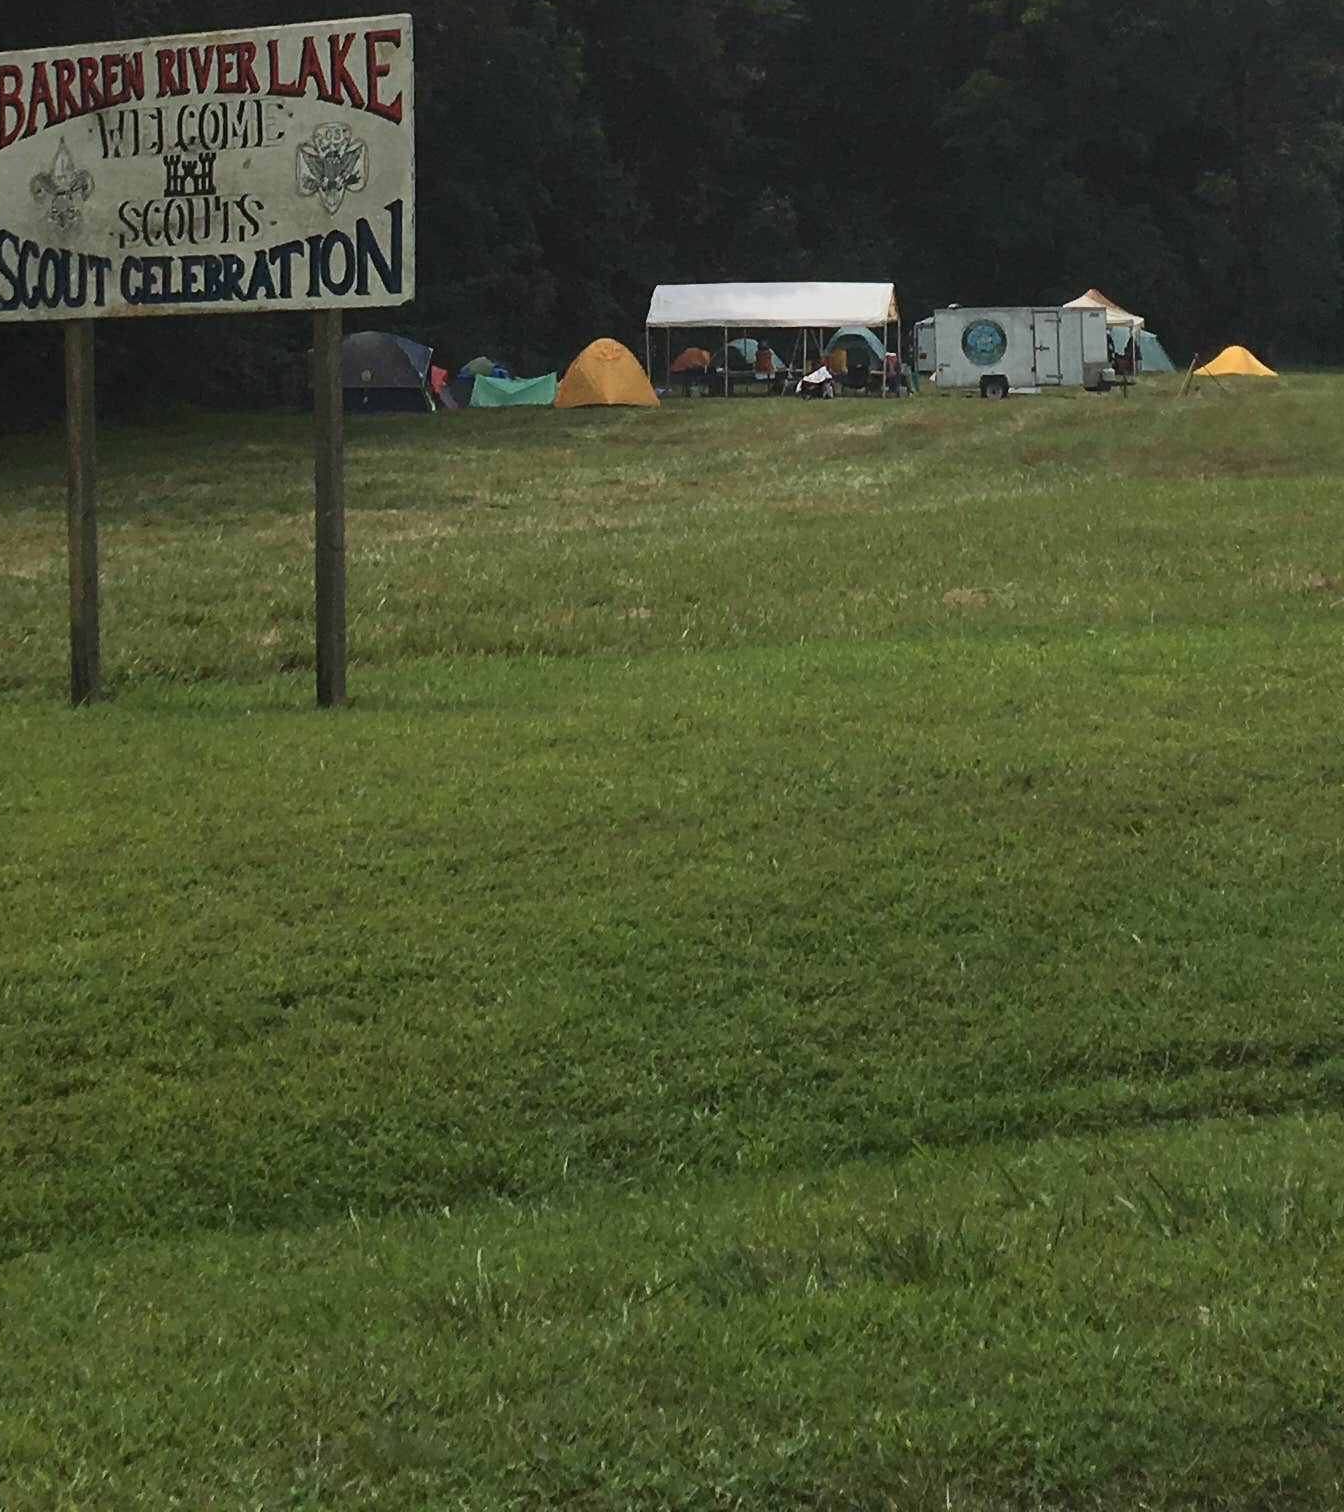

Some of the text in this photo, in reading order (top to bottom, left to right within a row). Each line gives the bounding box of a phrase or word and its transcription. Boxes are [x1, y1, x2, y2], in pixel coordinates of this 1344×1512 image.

[156, 41, 261, 98] RIVER
[267, 29, 403, 125] LAKE
[97, 99, 287, 159] WELCOME
[118, 193, 265, 248] SCOUTS
[120, 199, 403, 305] CELEBRATION
